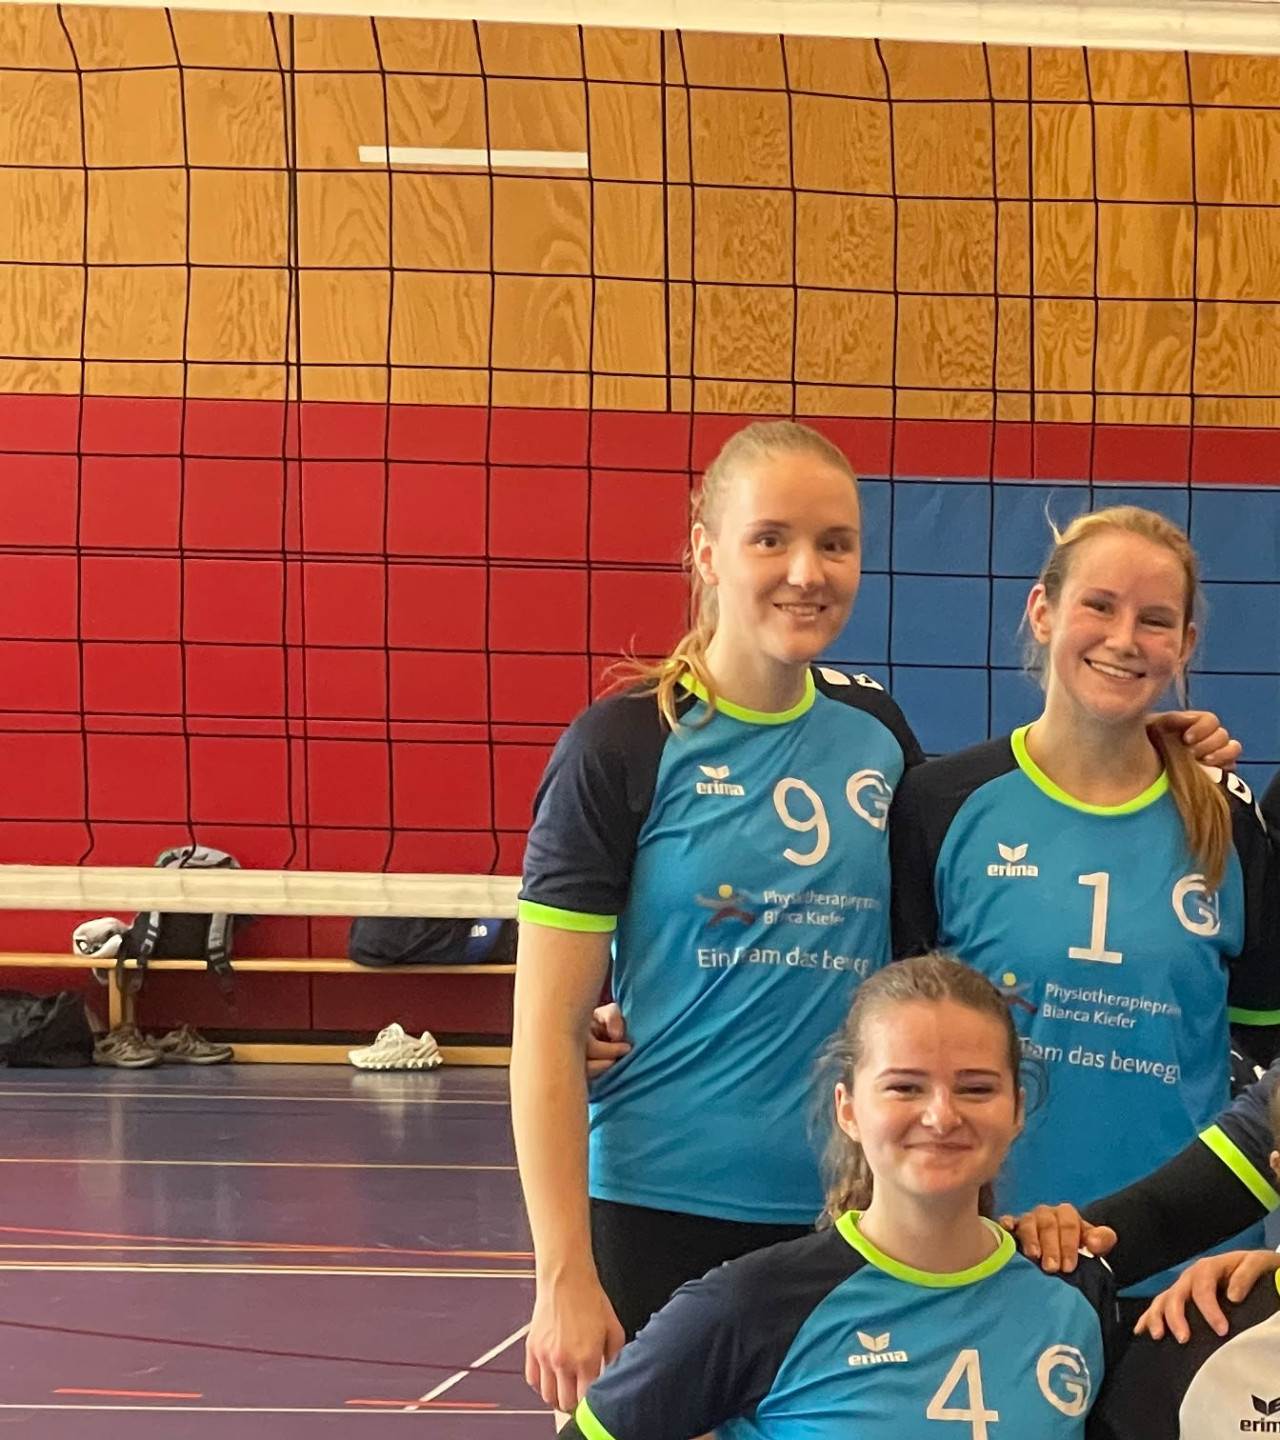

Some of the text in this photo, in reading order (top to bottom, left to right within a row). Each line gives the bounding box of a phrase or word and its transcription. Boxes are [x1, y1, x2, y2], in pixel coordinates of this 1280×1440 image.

[696, 780, 745, 796] erima
[773, 777, 830, 866] 9
[987, 863, 1039, 877] erima
[1068, 871, 1123, 964] 1
[1042, 1004, 1137, 1030] Bianca Kiefer
[1069, 1045, 1106, 1069] das
[1110, 1050, 1181, 1084] beweg
[848, 1350, 909, 1367] erima
